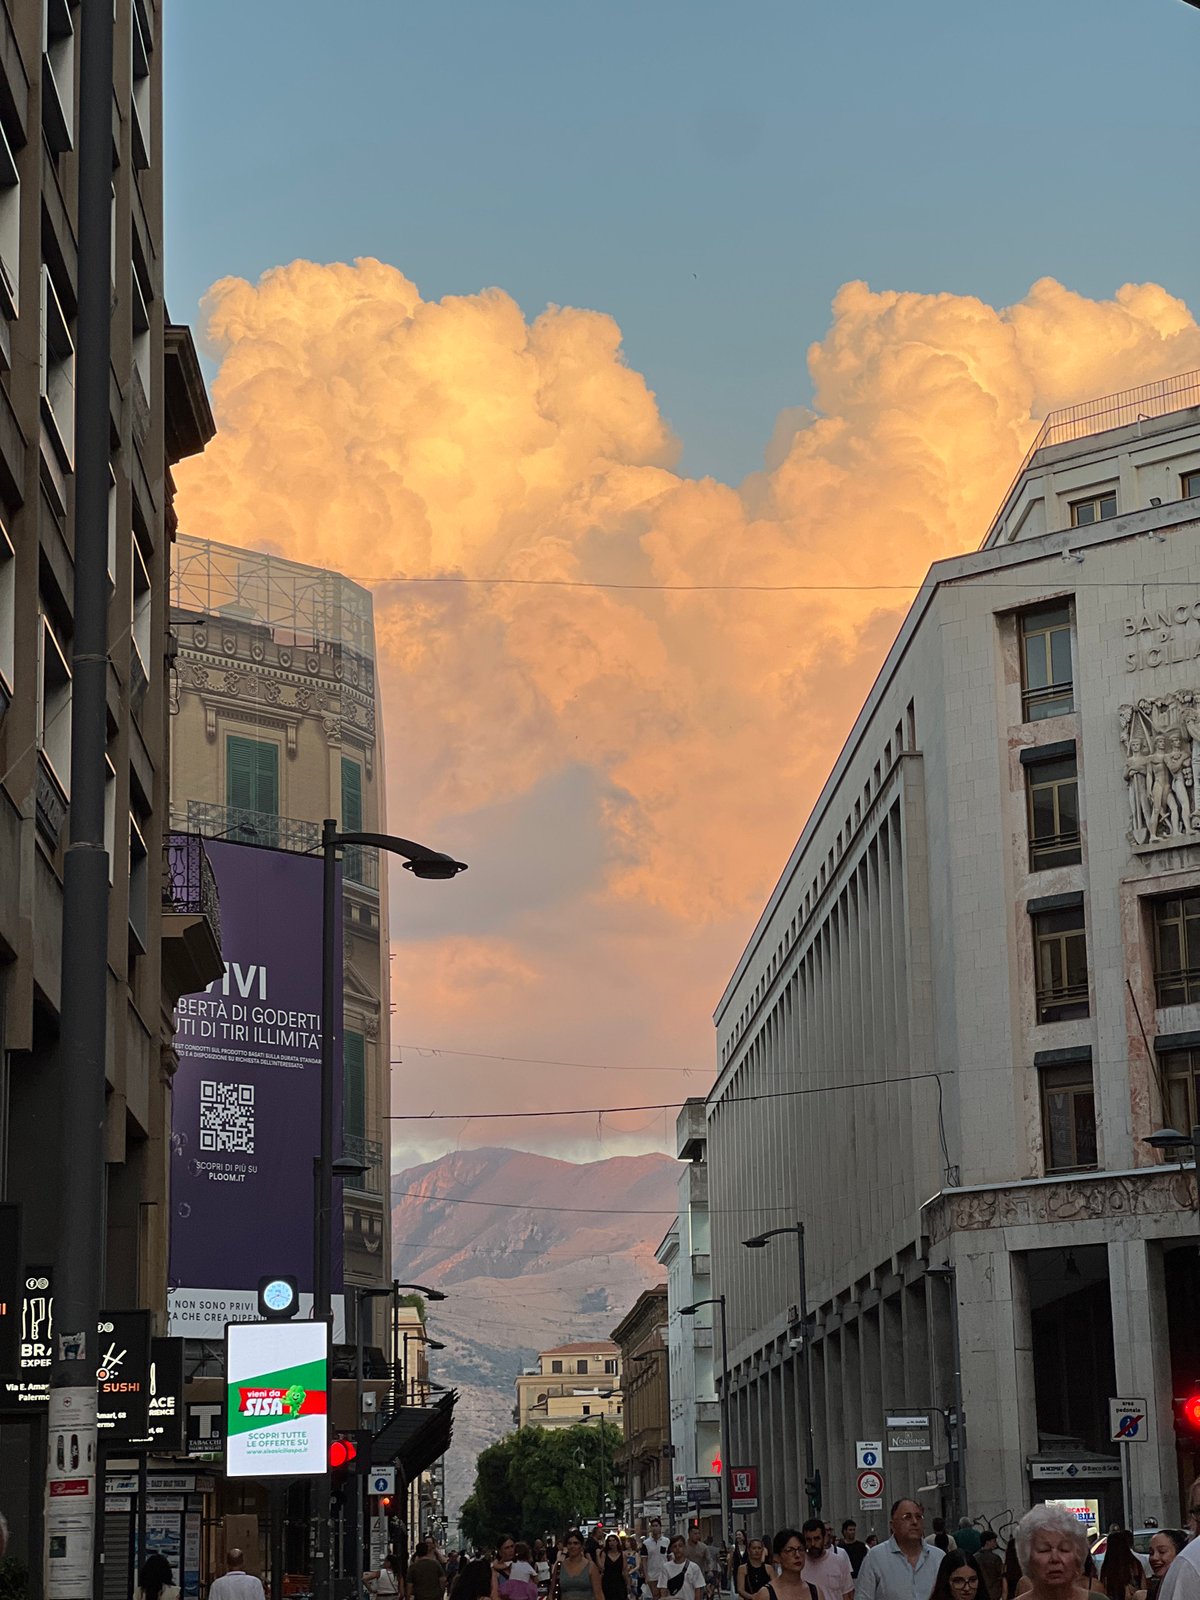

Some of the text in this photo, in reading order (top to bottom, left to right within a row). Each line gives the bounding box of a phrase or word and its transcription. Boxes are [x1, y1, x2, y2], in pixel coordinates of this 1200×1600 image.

[232, 1004, 247, 1022] DI
[252, 1006, 320, 1031] GODERTI
[200, 1020, 216, 1038] DI
[220, 1022, 249, 1042] TIRI
[299, 1057, 322, 1065] STANDAR
[196, 1161, 258, 1173] SCOPRI DI PIÙ SU
[208, 1172, 246, 1182] PLOOM.IT
[175, 1300, 196, 1309] NON
[199, 1301, 227, 1311] SONO
[229, 1302, 254, 1311] PRIVI
[181, 1312, 201, 1321] CHE
[203, 1313, 229, 1322] CREA
[5, 1383, 19, 1391] Via
[102, 1382, 140, 1393] SUSHI
[247, 1389, 281, 1398] vieni da
[148, 1396, 176, 1409] ACE
[243, 1397, 283, 1417] SISA
[190, 1405, 222, 1439] T
[248, 1431, 307, 1440] SCOPRI TUTTE
[246, 1438, 309, 1448] LE OFFERTE SU
